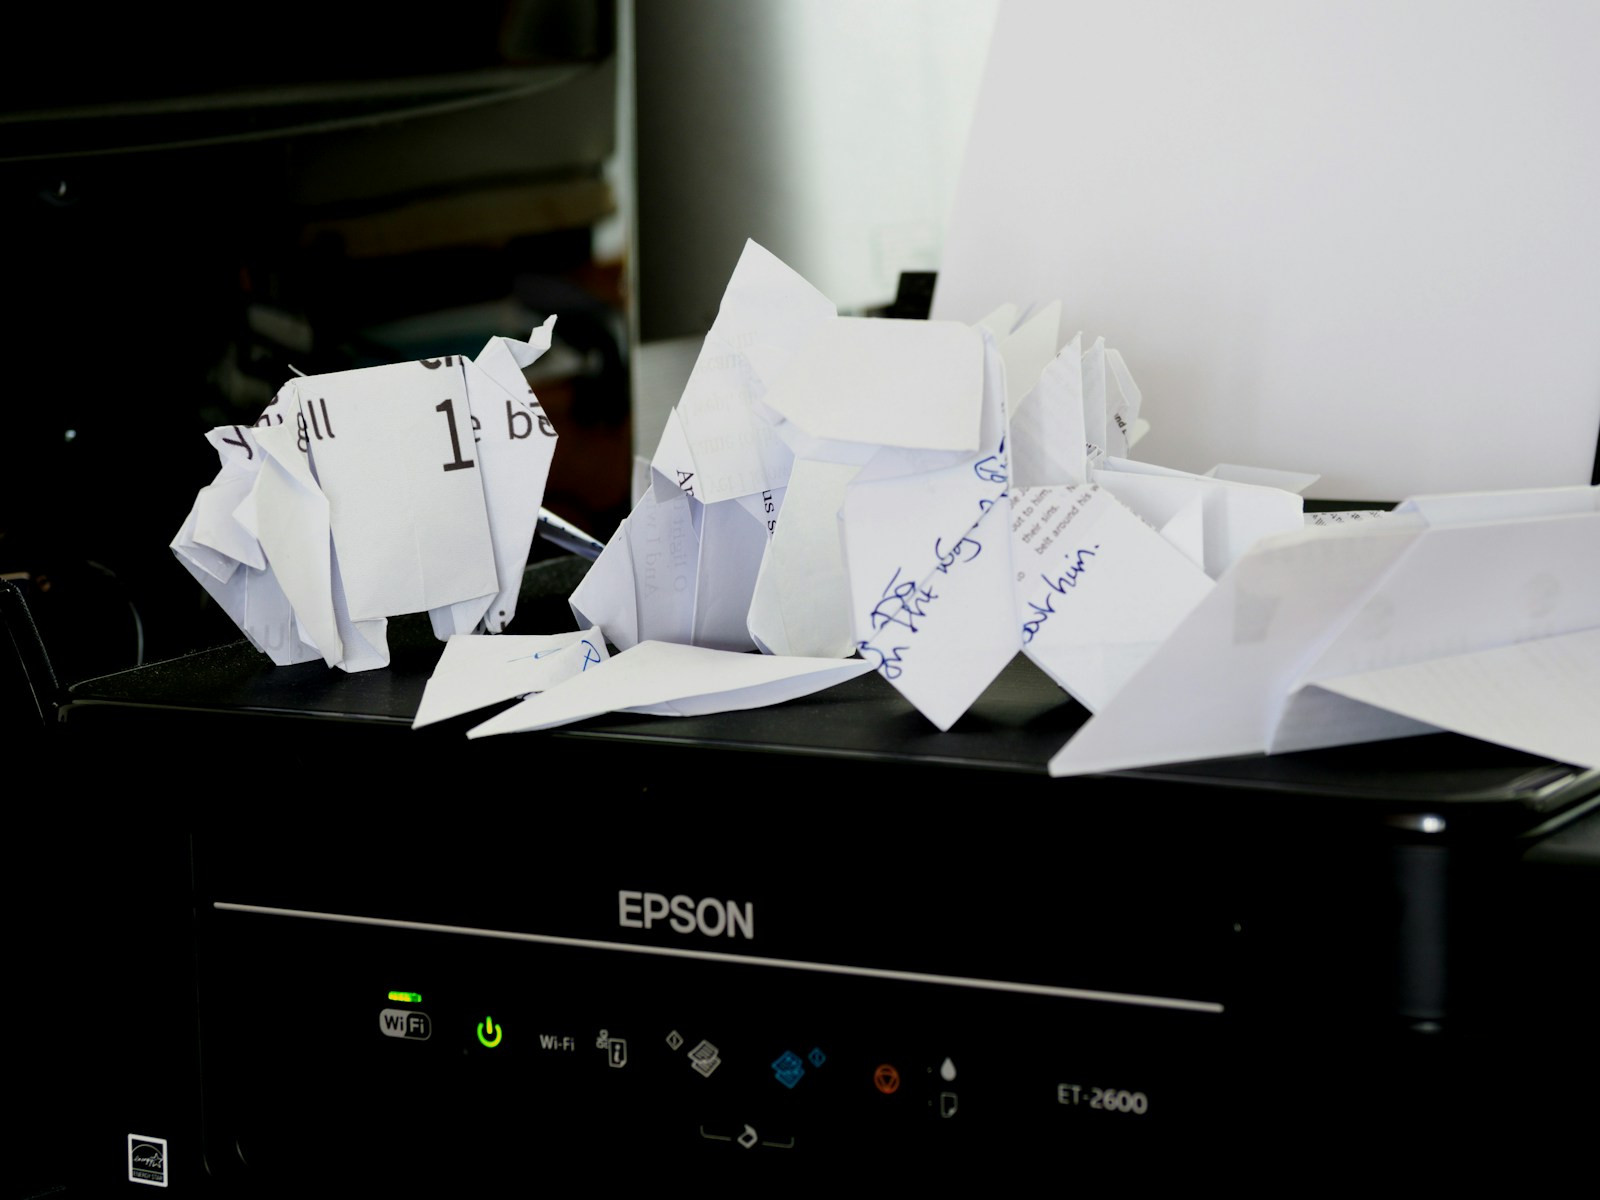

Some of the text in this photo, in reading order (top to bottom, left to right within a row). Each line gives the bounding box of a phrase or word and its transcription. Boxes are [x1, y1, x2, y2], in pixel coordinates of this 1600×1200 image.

[435, 399, 474, 472] 1
[1022, 505, 1034, 517] to
[1034, 535, 1054, 555] belt
[1051, 504, 1080, 537] around
[1077, 491, 1093, 506] his
[1021, 522, 1042, 544] their
[619, 890, 754, 939] EPSON
[539, 1034, 575, 1051] Wi-Fi
[1057, 1083, 1149, 1115] ET-2600
